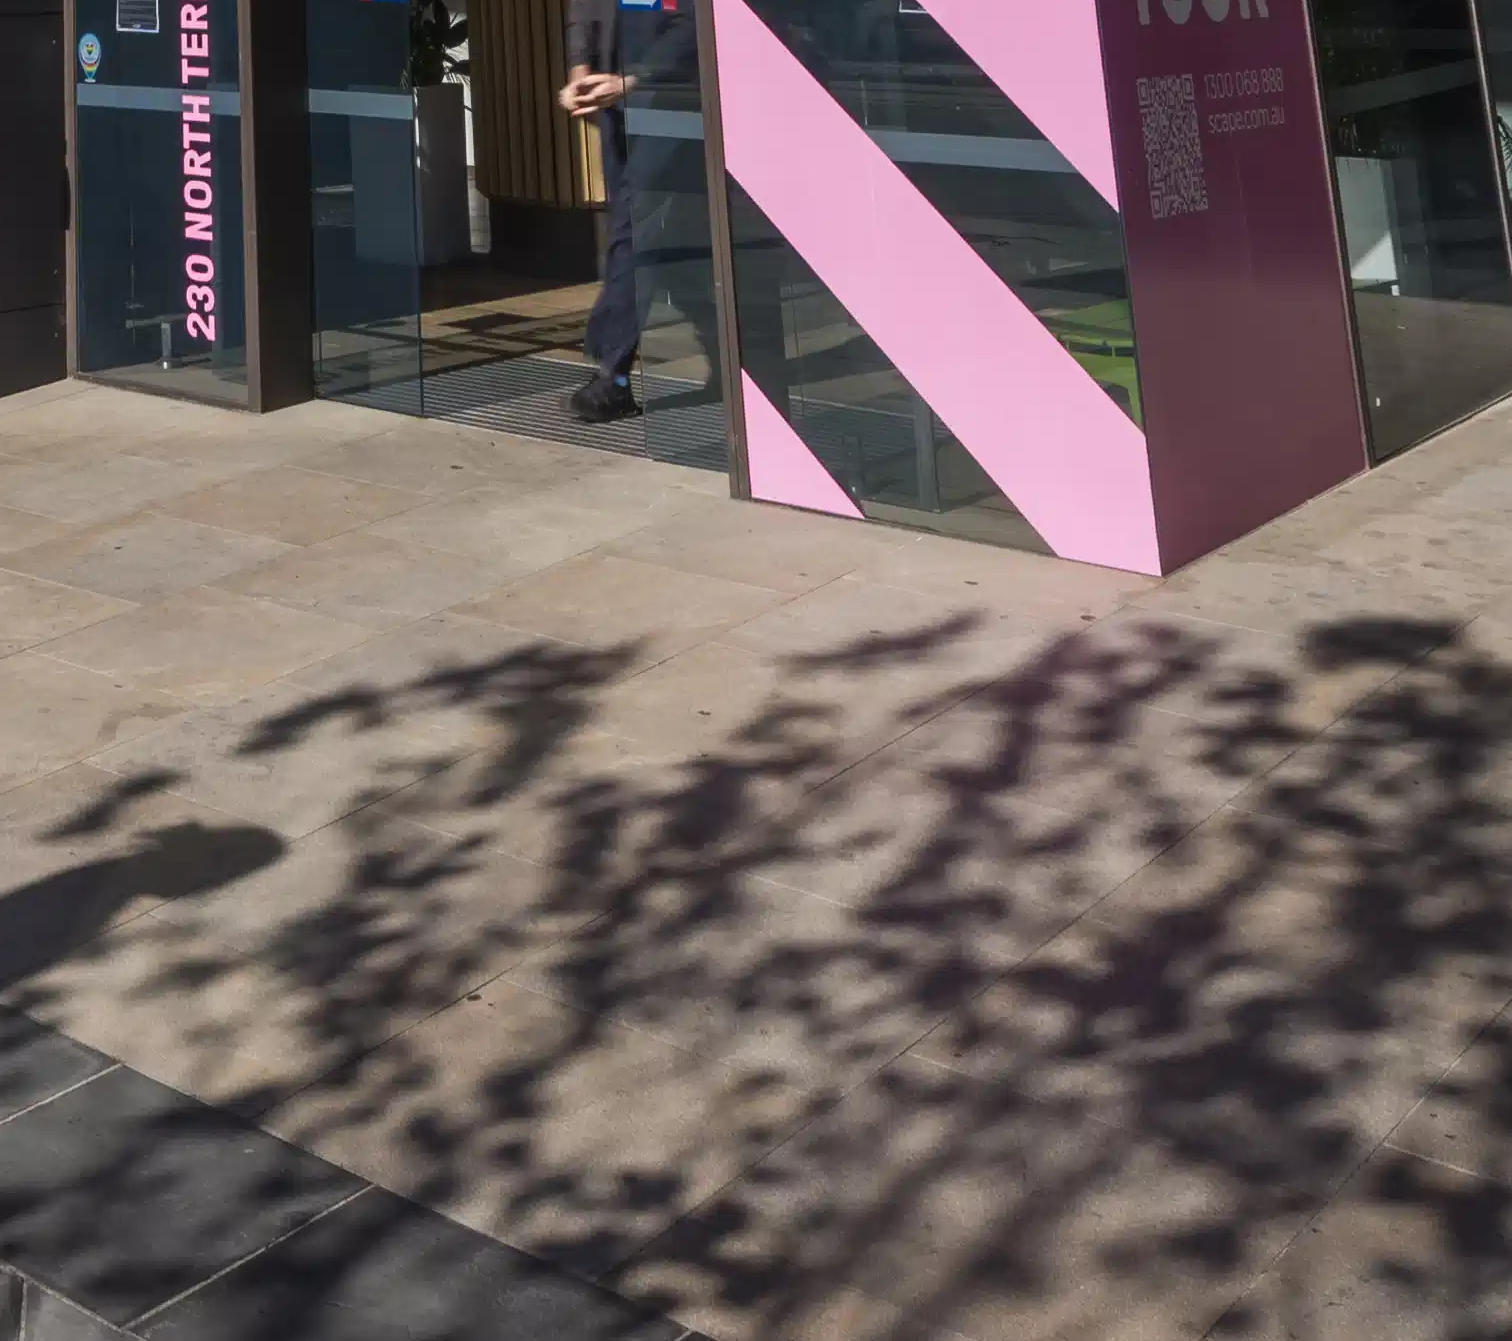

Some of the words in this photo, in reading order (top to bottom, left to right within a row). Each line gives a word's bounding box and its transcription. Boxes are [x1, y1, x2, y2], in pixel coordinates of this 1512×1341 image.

[1207, 106, 1286, 137] scape.com.au
[182, 94, 214, 242] NORTH
[185, 253, 217, 342] 230
